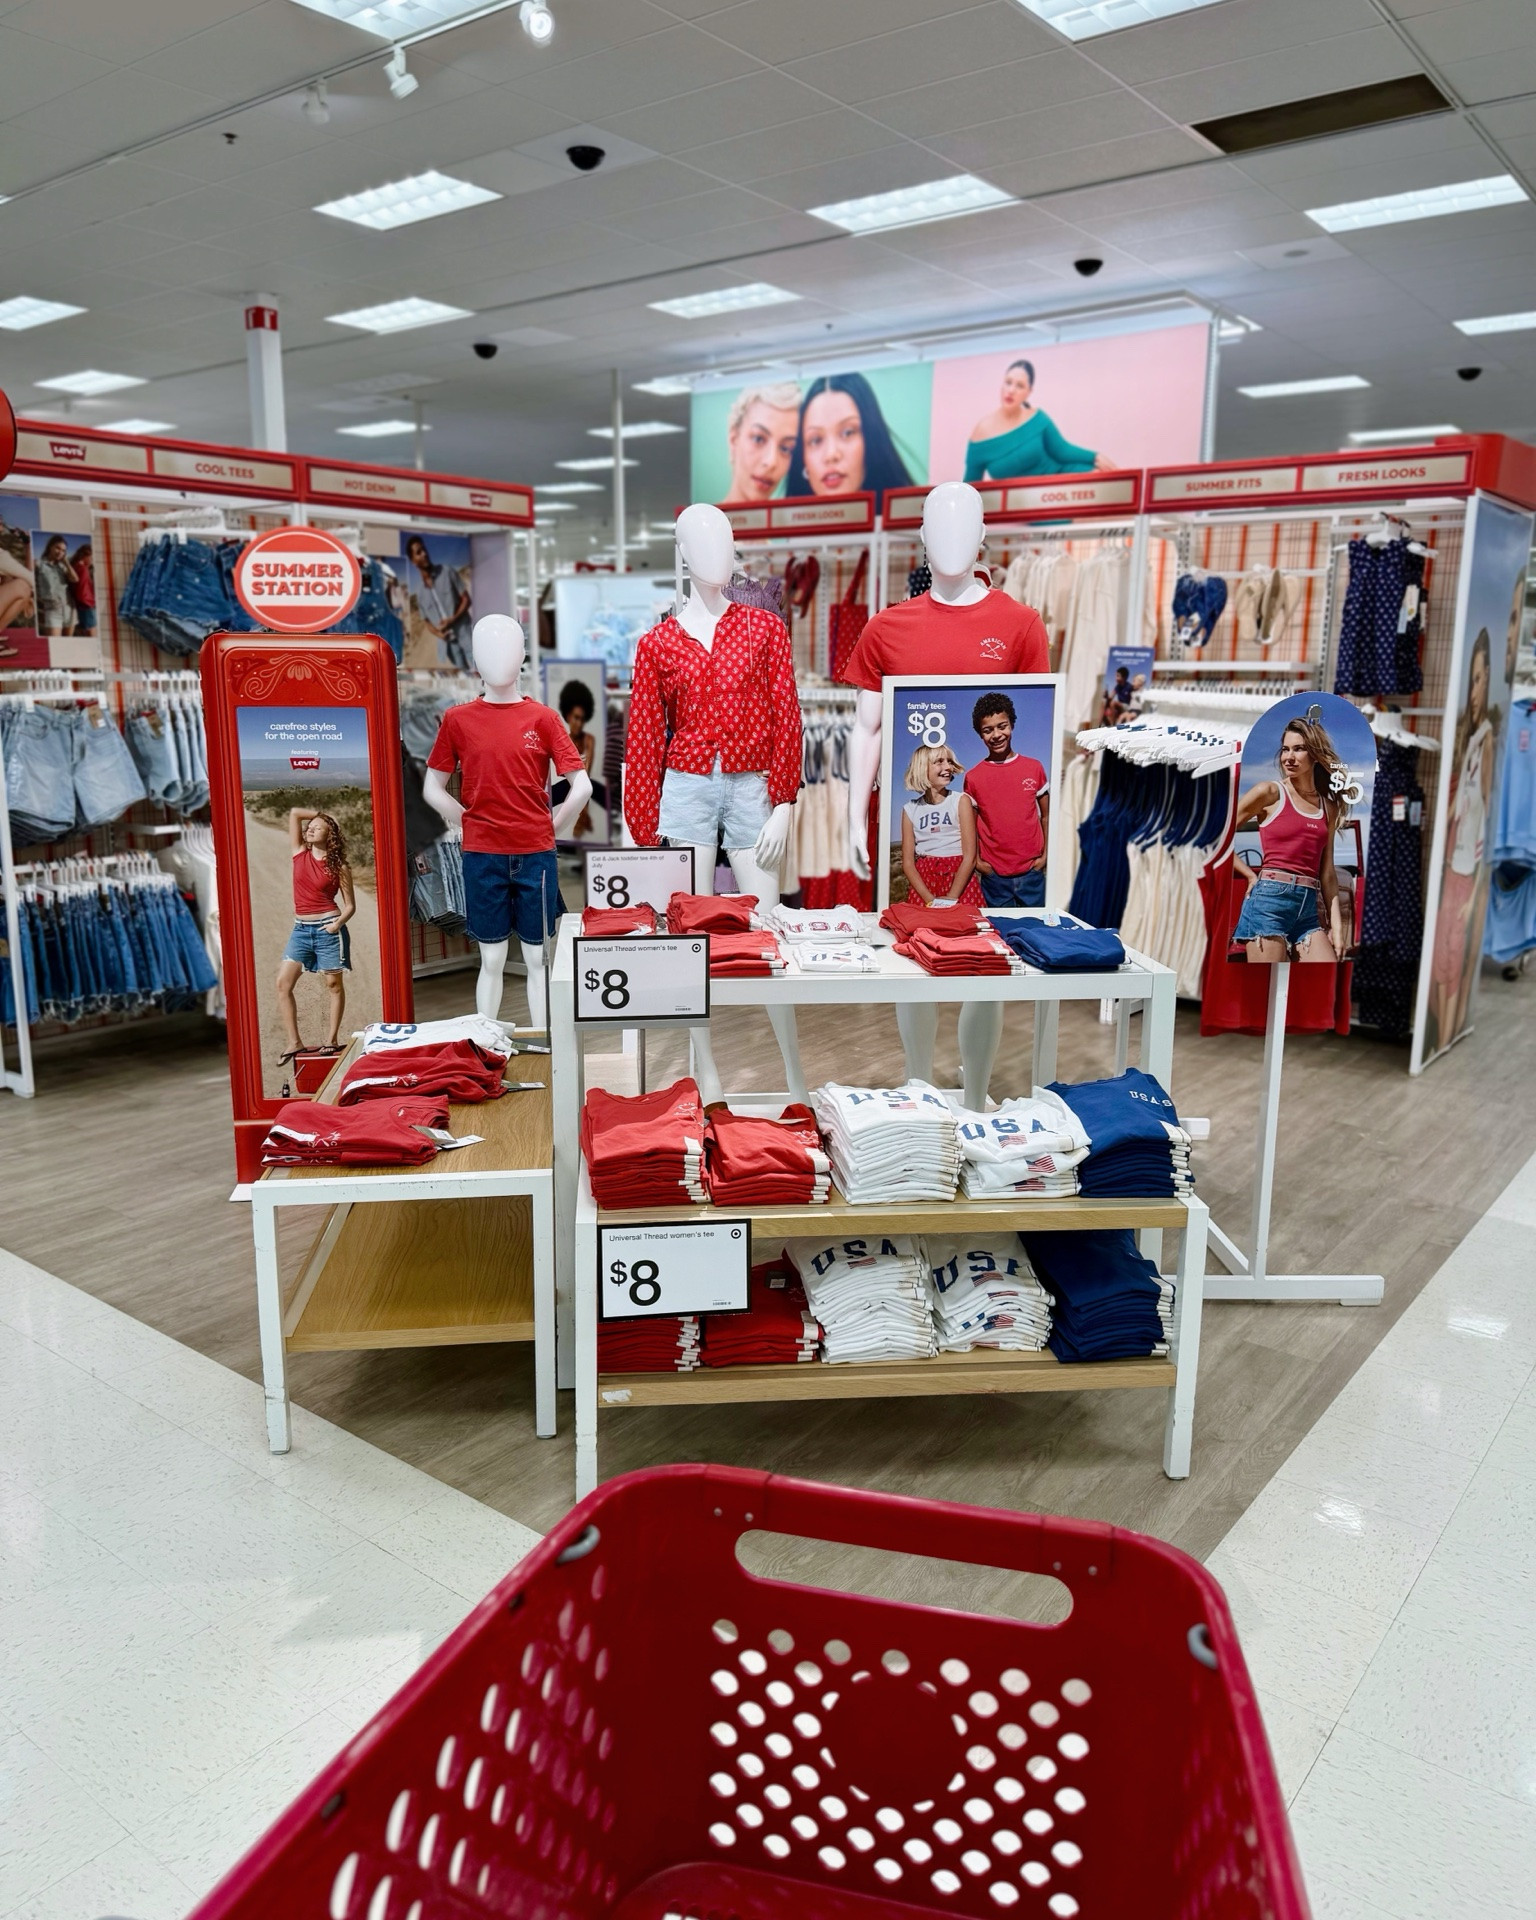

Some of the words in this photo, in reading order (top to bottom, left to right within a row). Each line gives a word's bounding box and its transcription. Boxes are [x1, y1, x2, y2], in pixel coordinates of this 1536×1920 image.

[195, 462, 226, 477] COOL
[228, 466, 255, 479] TEES
[1337, 470, 1378, 483] FRESH
[1381, 466, 1427, 480] LOOKS
[344, 479, 364, 491] HOT
[366, 481, 396, 494] DENIM
[1185, 480, 1234, 492] SUMMER
[1237, 478, 1263, 489] FITS
[1041, 492, 1068, 503] COOL
[1072, 489, 1096, 500] TEES
[792, 511, 817, 521] FRESH
[818, 509, 846, 520] LOOKS
[251, 563, 344, 578] SUMMER
[251, 581, 343, 596] STATION
[907, 702, 930, 711] family
[931, 702, 946, 710] tees
[270, 722, 308, 731] carefree
[309, 722, 337, 732] styles
[907, 711, 947, 748] $8
[264, 732, 278, 741] for
[280, 732, 295, 740] the
[296, 733, 320, 742] open
[322, 732, 343, 741] road
[1328, 770, 1364, 804] $5
[919, 811, 953, 830] USA
[592, 874, 630, 908] $8
[583, 945, 613, 953] Universal
[584, 967, 630, 1010] $8
[846, 1090, 949, 1110] USA
[959, 1118, 1059, 1140] USA
[609, 1233, 642, 1242] Universal
[643, 1232, 668, 1240] Thread
[669, 1231, 701, 1239] women's
[811, 1239, 898, 1276] USA
[610, 1258, 662, 1306] $8
